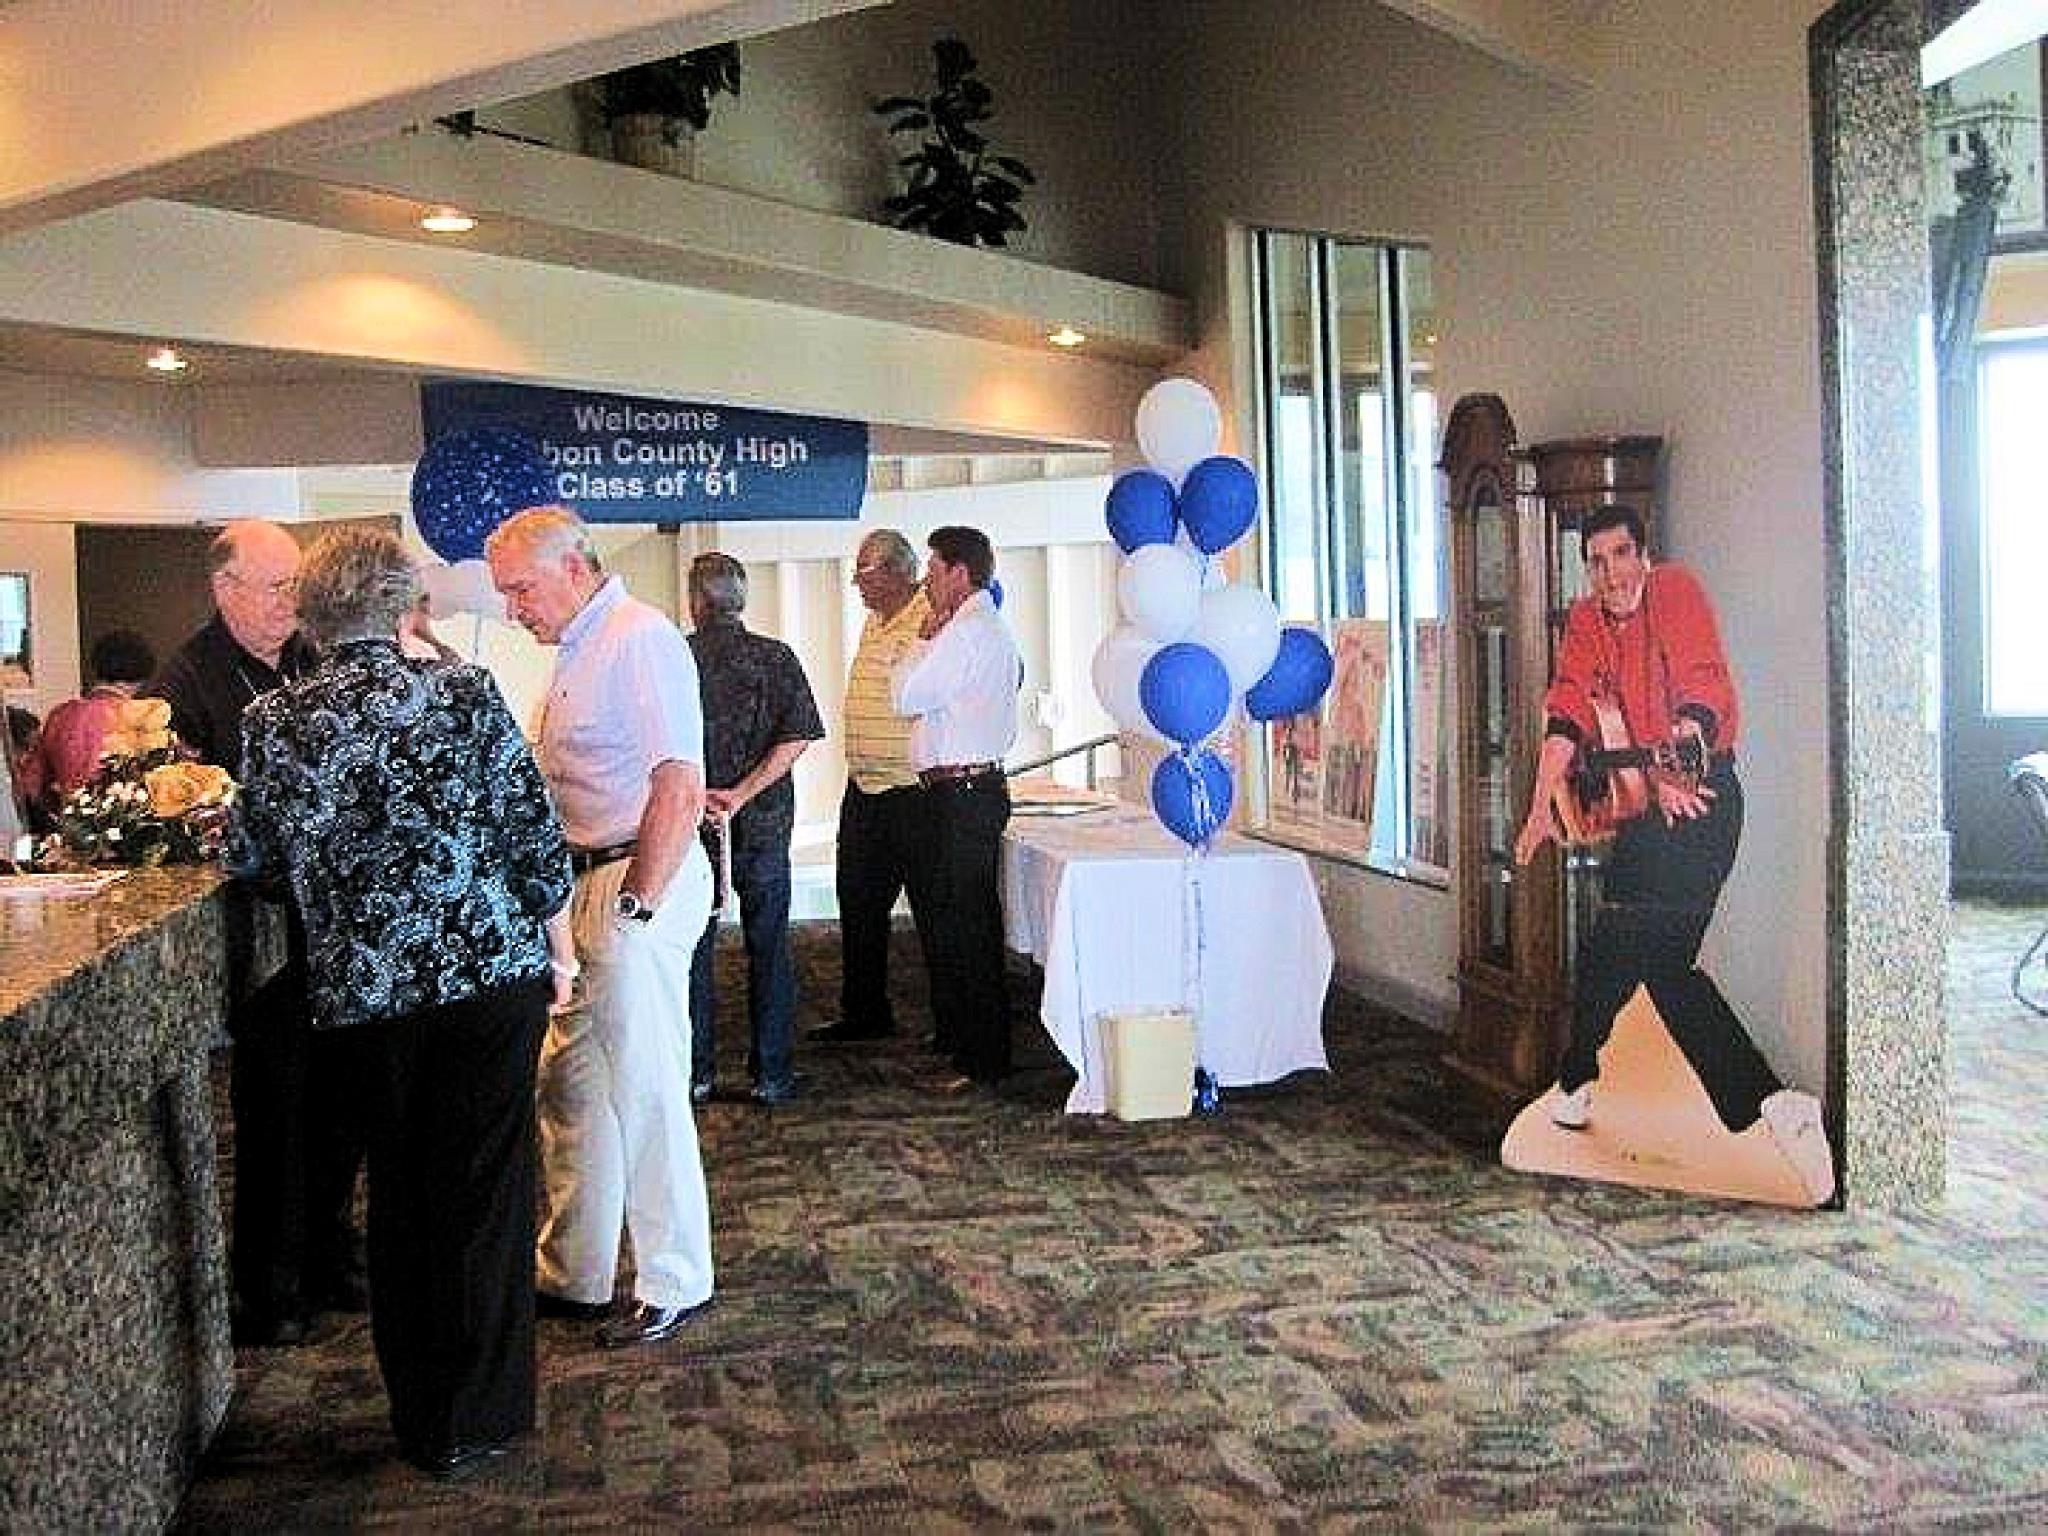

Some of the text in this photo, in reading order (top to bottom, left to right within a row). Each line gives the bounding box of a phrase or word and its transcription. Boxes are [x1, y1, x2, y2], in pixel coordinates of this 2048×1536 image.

[574, 406, 719, 431] Welcome
[613, 438, 724, 471] County
[736, 437, 807, 468] High
[557, 471, 644, 499] Class
[655, 469, 687, 497] of
